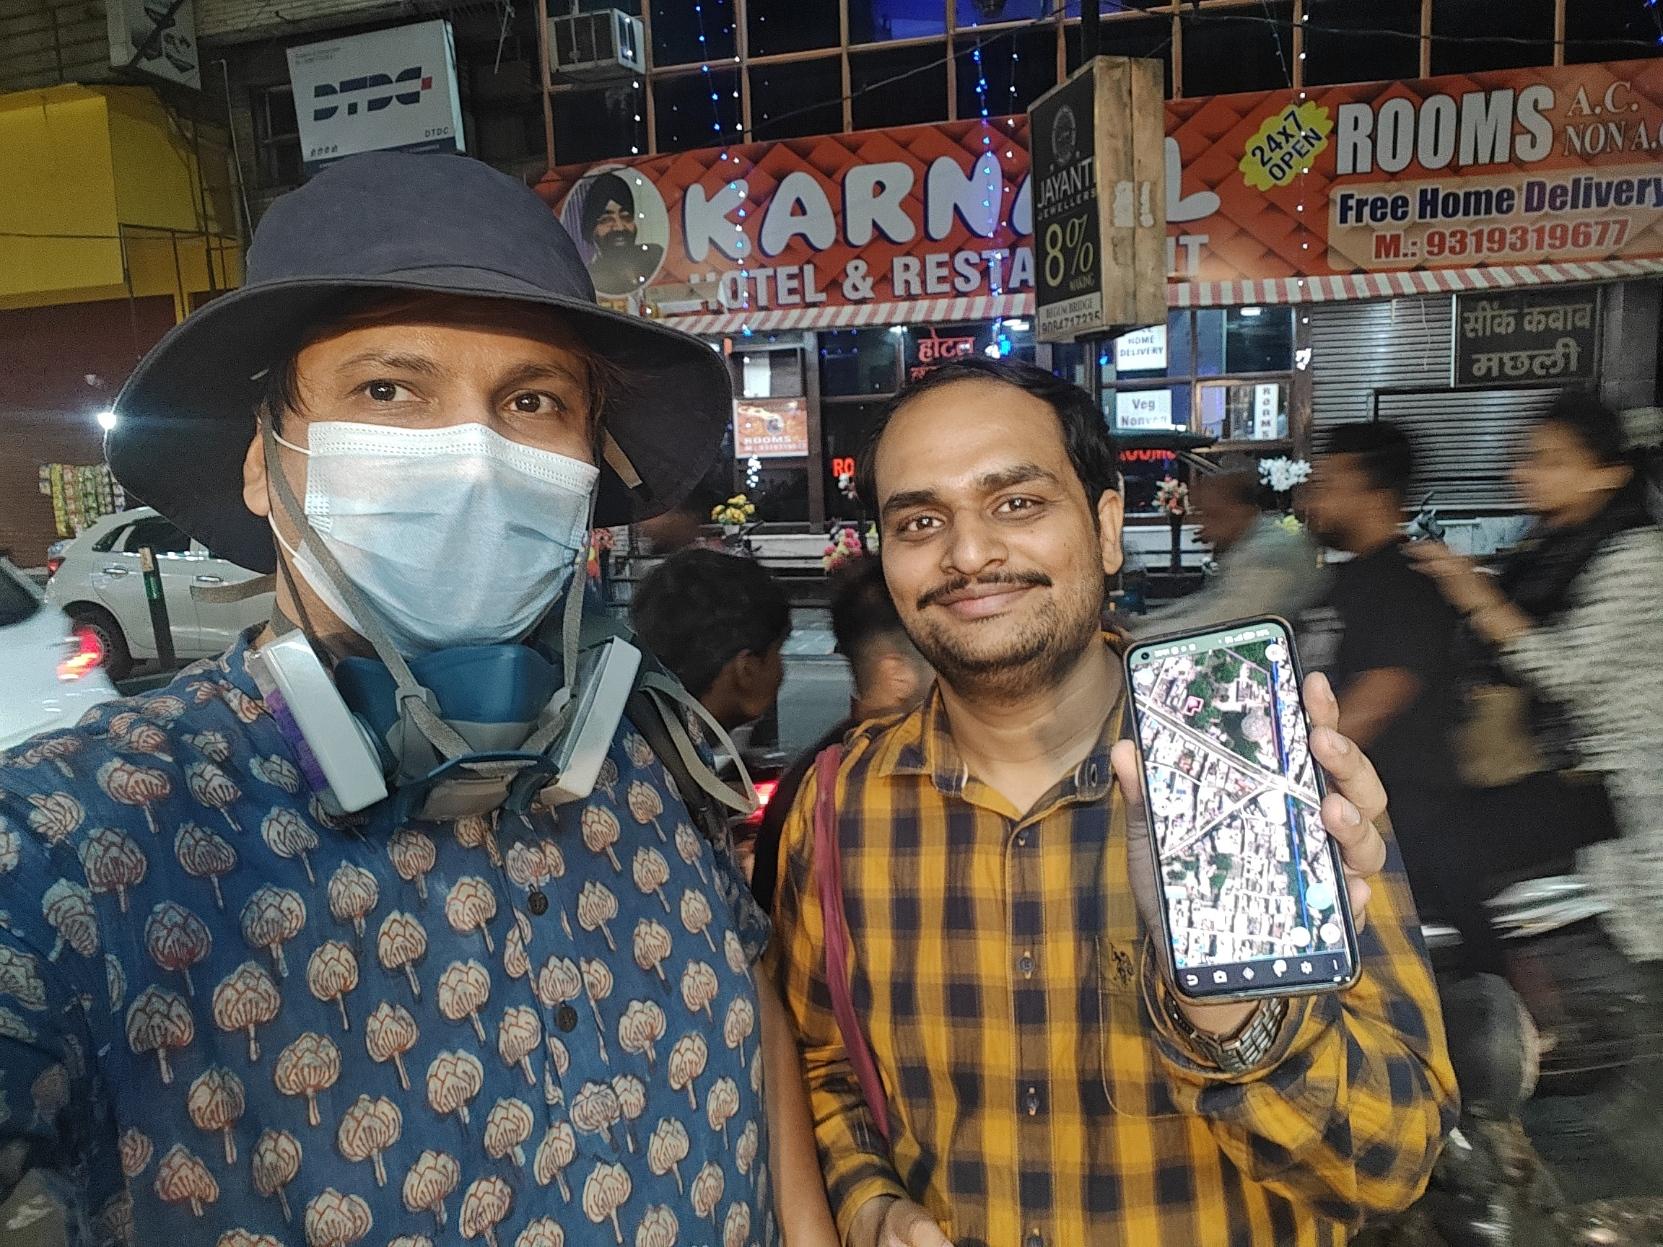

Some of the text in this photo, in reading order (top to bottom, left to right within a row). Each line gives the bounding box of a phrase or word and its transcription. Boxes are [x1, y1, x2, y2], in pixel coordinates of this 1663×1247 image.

[314, 66, 423, 122] DTDC
[1567, 81, 1639, 117] A.C.
[424, 126, 450, 138] DTDC
[1336, 84, 1554, 175] ROOMS
[1563, 119, 1663, 157] NON A.
[1269, 127, 1323, 182] OPEN
[1338, 193, 1410, 225] Free
[1418, 187, 1516, 220] Home
[1045, 213, 1094, 288] 8%
[1426, 218, 1629, 257] 9319319677
[842, 259, 876, 299] &
[1120, 347, 1164, 357] DELIVERY
[1128, 335, 1155, 345] HOME
[1132, 399, 1156, 411] Veg
